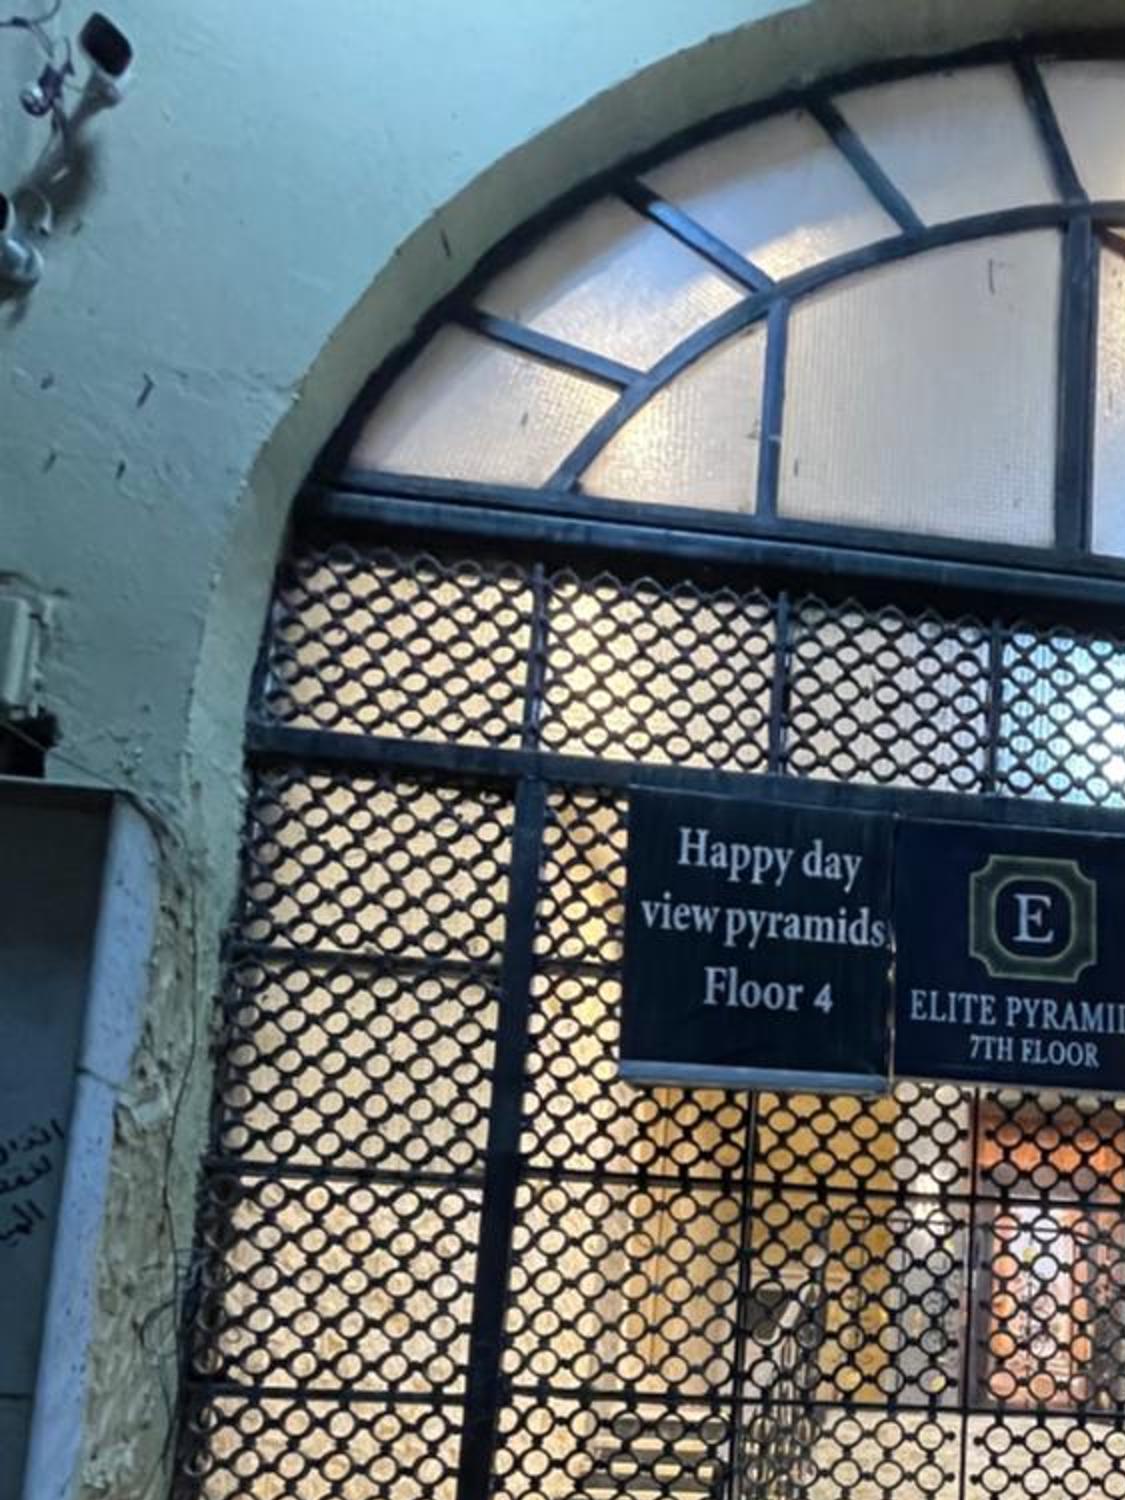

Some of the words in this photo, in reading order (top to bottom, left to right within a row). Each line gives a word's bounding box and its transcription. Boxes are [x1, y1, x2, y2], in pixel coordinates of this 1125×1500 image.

[676, 826, 794, 888] Happy
[801, 838, 863, 894] day
[640, 889, 720, 933] view
[724, 906, 887, 950] pyramids
[1012, 892, 1056, 944] E
[703, 966, 804, 1012] Floor
[813, 982, 834, 1015] 4
[910, 988, 997, 1026] ELITE
[969, 1033, 1014, 1063] 7TH
[1020, 1037, 1100, 1069] FLOOR
